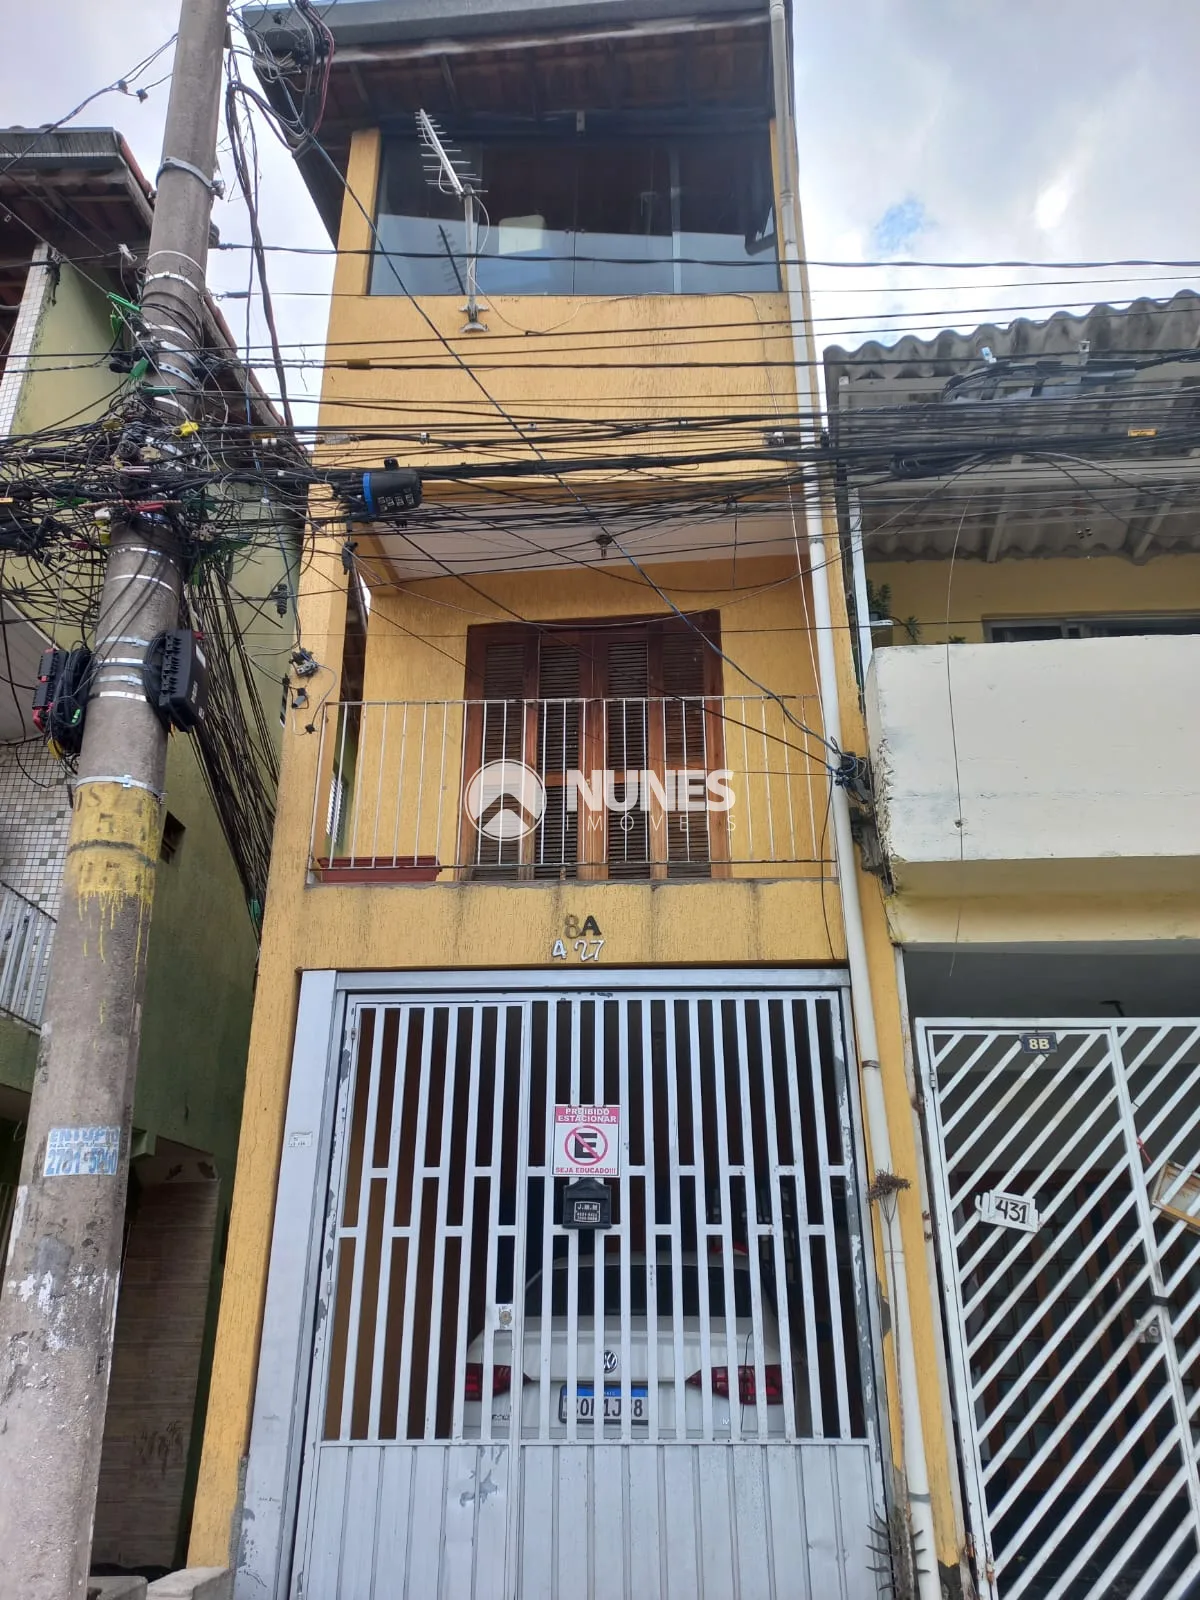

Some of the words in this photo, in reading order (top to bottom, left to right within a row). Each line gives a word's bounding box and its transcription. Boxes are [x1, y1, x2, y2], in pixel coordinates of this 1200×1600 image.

[564, 914, 602, 939] 8A
[1028, 1038, 1050, 1050] 8B
[565, 1107, 610, 1116] PROIBIDO
[557, 1115, 617, 1123] ESTACIONAR
[995, 1199, 1027, 1224] 431
